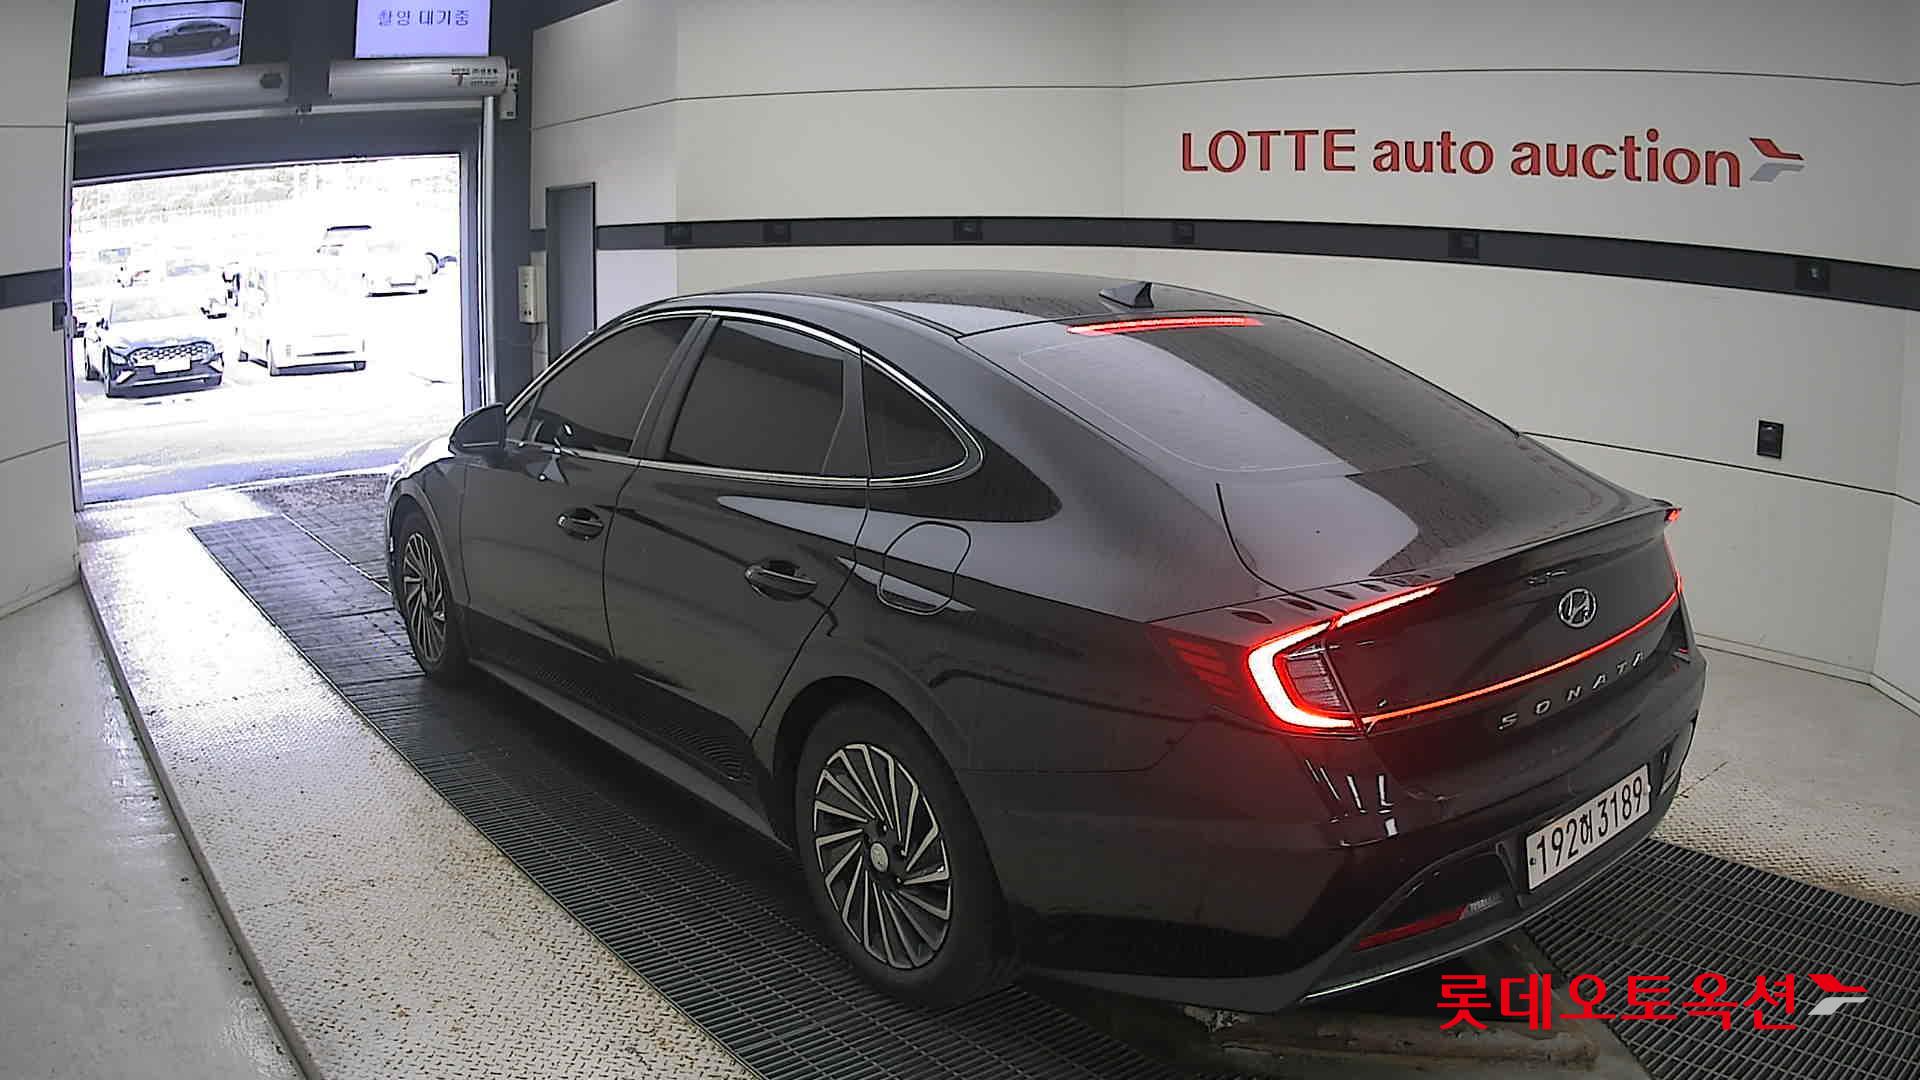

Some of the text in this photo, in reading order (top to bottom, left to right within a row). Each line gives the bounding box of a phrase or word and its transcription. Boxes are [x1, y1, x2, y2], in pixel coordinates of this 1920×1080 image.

[419, 9, 470, 26] 대기중
[1181, 127, 1742, 188] LOTTE auto auction
[1498, 651, 1644, 731] SONATA
